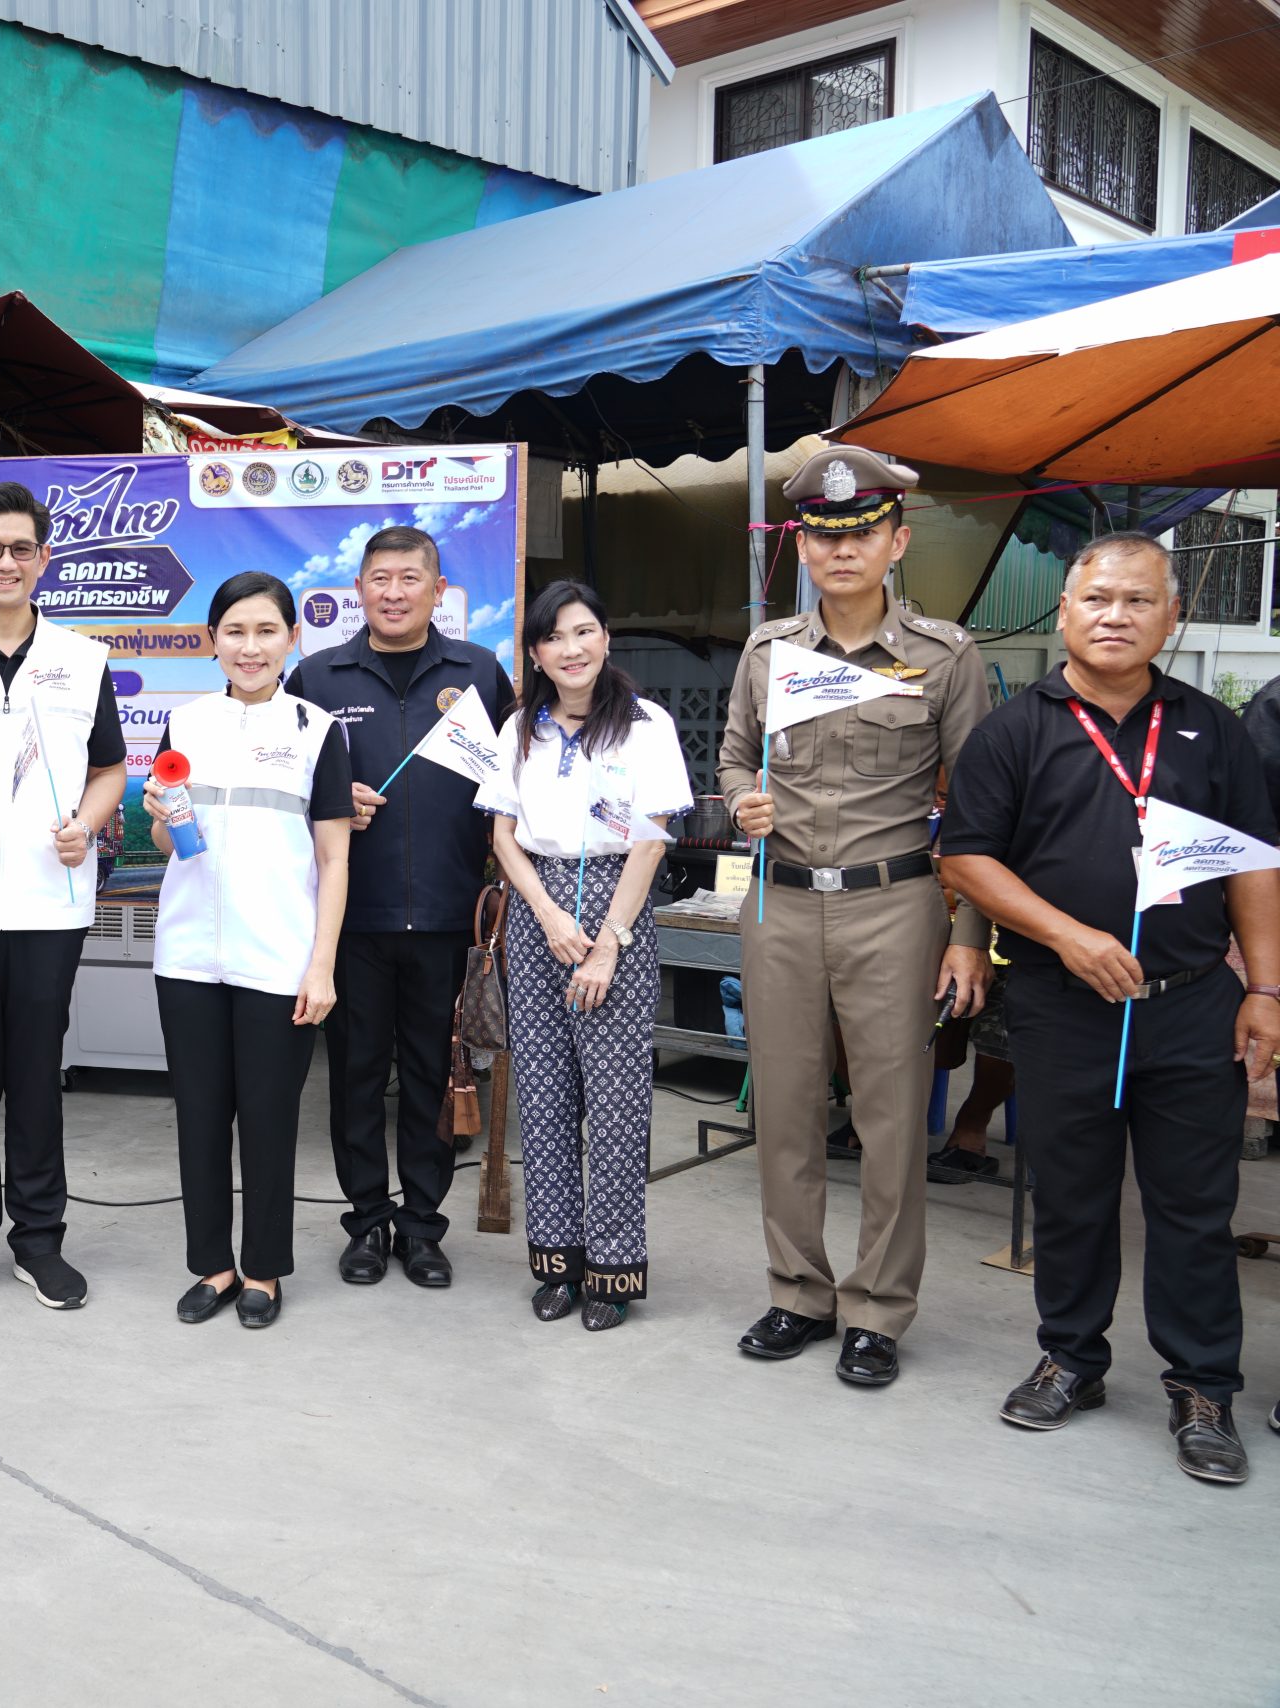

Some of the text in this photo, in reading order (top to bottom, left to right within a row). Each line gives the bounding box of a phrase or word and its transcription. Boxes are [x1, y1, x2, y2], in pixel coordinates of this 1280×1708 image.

[381, 480, 435, 489] กรมการค้าภายใน
[59, 561, 147, 582] ลดภาระ
[36, 586, 170, 606] ลดค่าครองชีพ
[342, 598, 361, 609] สิน
[99, 629, 202, 656] รถพุ่มพวง
[776, 666, 863, 695] ไทยช่วยไทย
[126, 755, 152, 766] 569
[1149, 836, 1246, 867] ไทยช่วยไทย
[531, 1253, 567, 1274] UIS
[585, 1271, 644, 1294] UITTON
